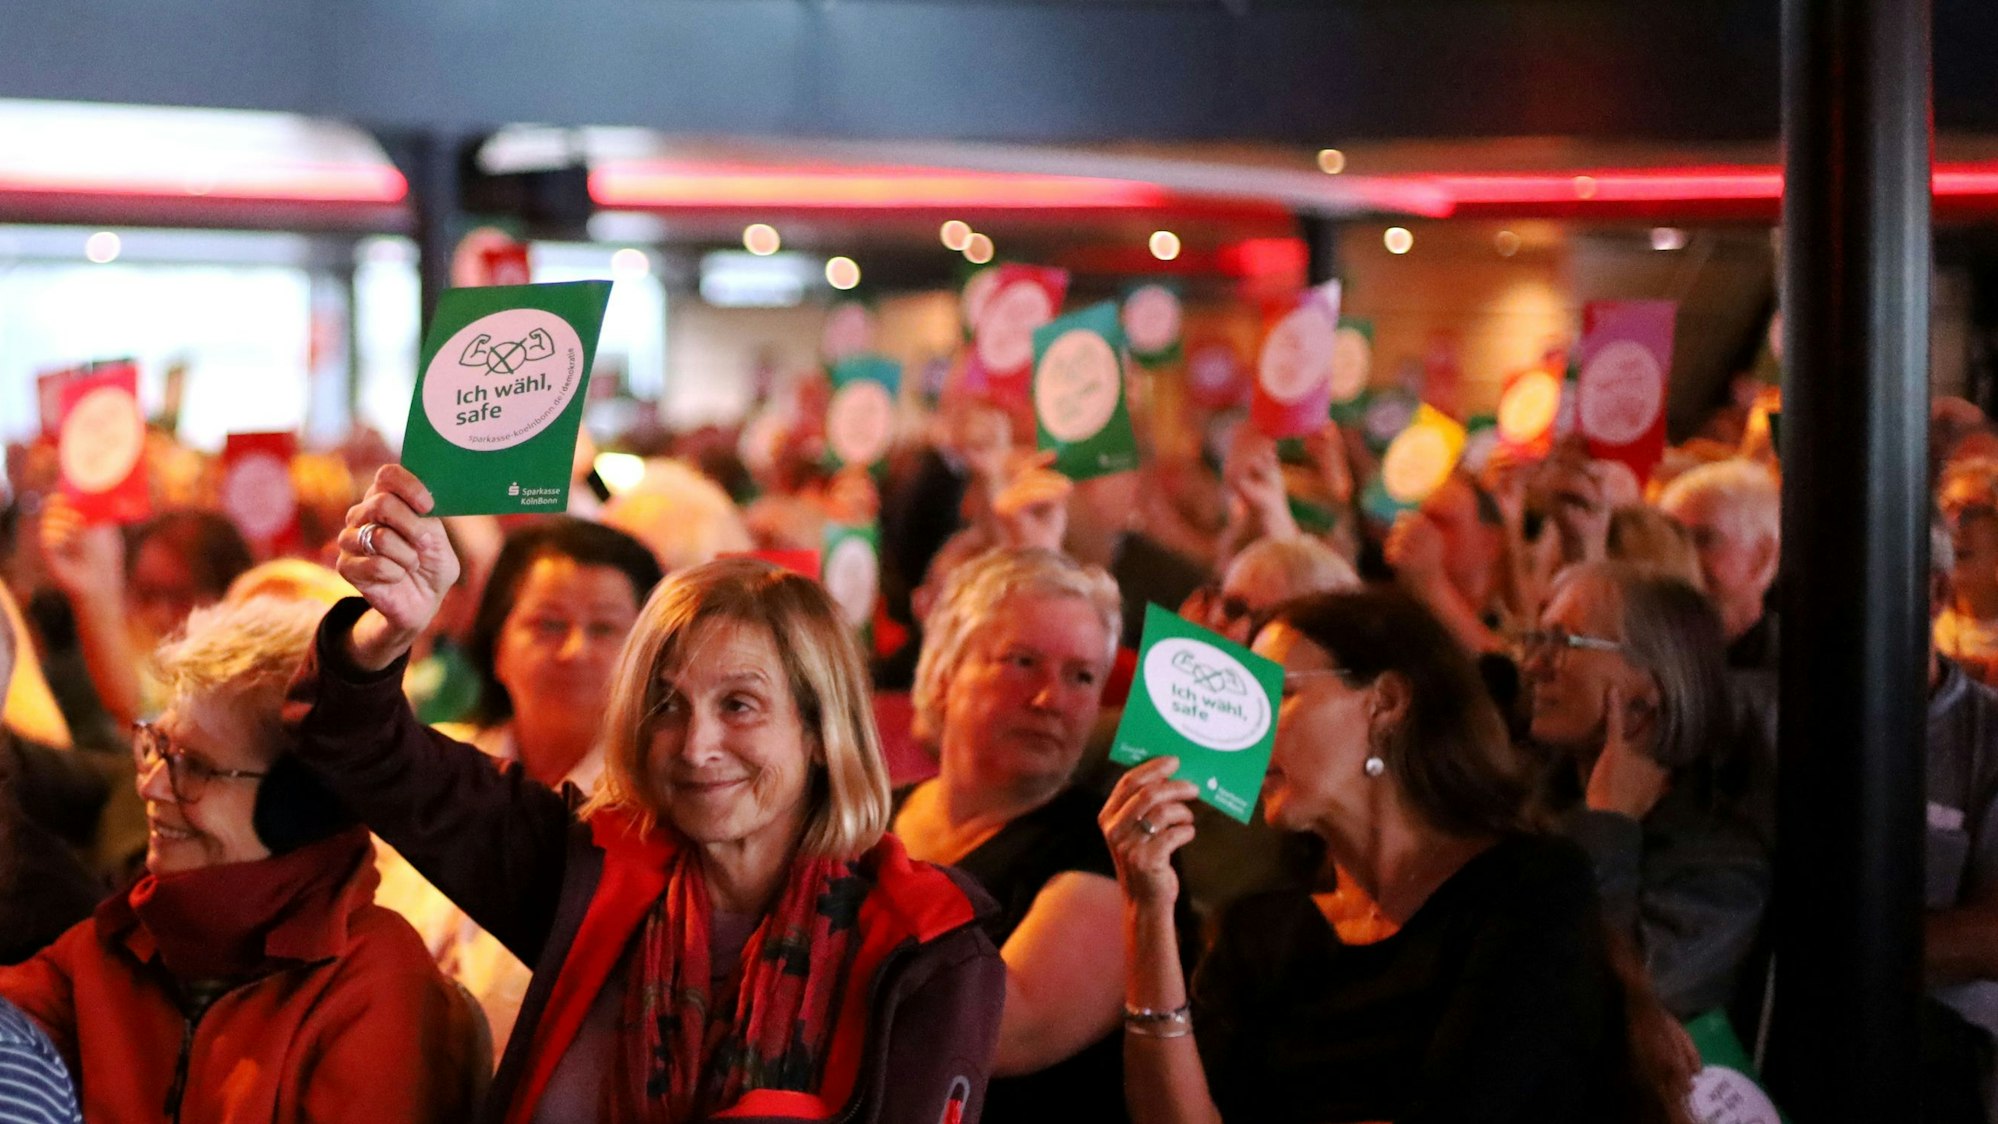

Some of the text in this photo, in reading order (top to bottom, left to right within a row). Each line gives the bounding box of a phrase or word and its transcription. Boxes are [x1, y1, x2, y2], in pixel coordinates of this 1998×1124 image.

[456, 373, 552, 405] Ich wähl,
[456, 402, 502, 425] safe
[521, 496, 558, 505] KölnBonn
[522, 488, 560, 497] Sparkasse
[1171, 683, 1197, 701] Ich
[1202, 695, 1247, 722] wähl,
[1172, 701, 1209, 721] safe
